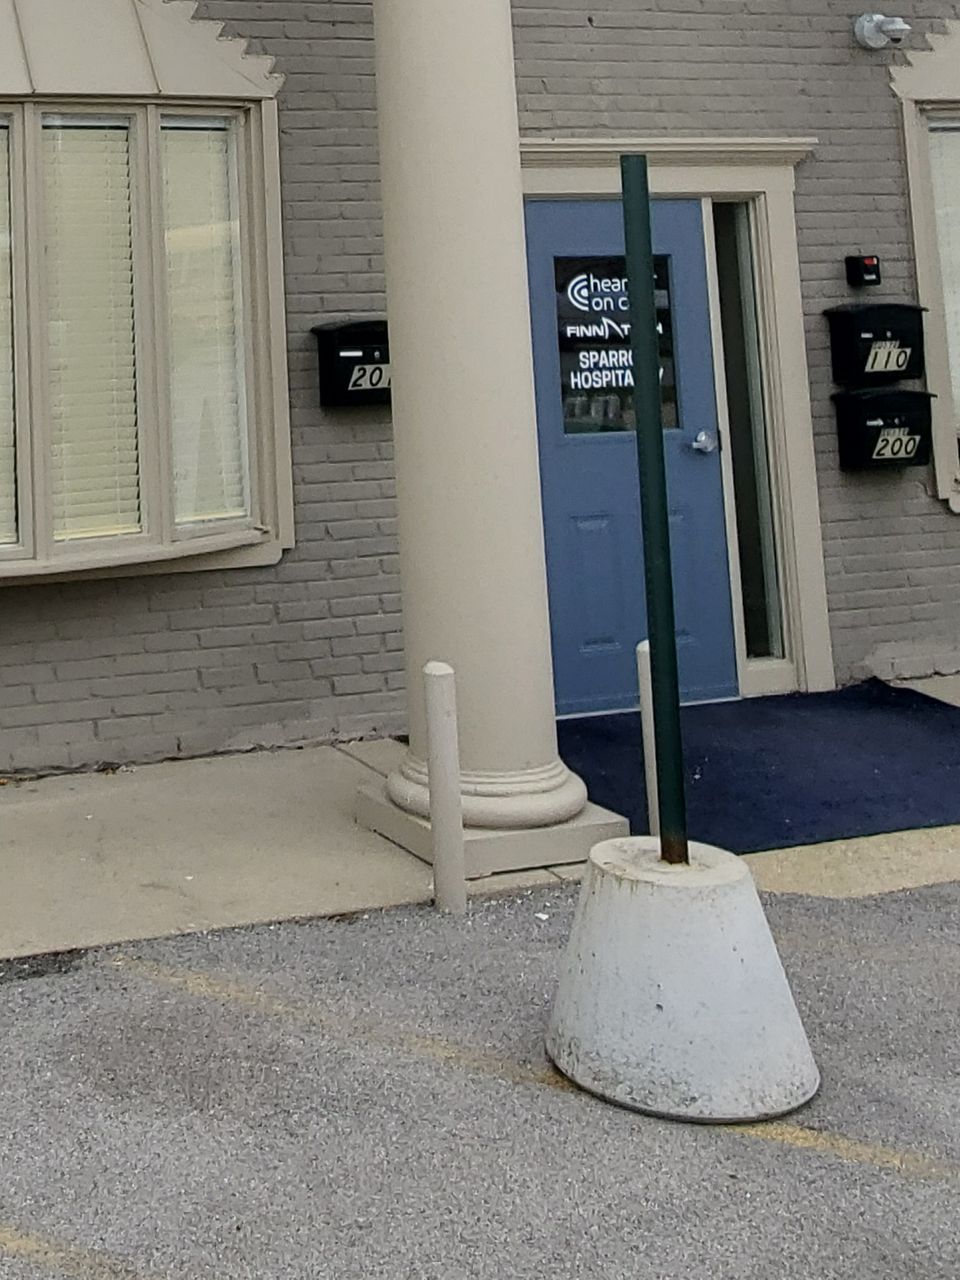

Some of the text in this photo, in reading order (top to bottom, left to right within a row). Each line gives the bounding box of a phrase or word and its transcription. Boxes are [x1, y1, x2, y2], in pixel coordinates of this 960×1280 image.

[590, 273, 628, 292] hear
[591, 297, 614, 311] on
[871, 349, 907, 369] 110
[875, 436, 916, 457] 200
